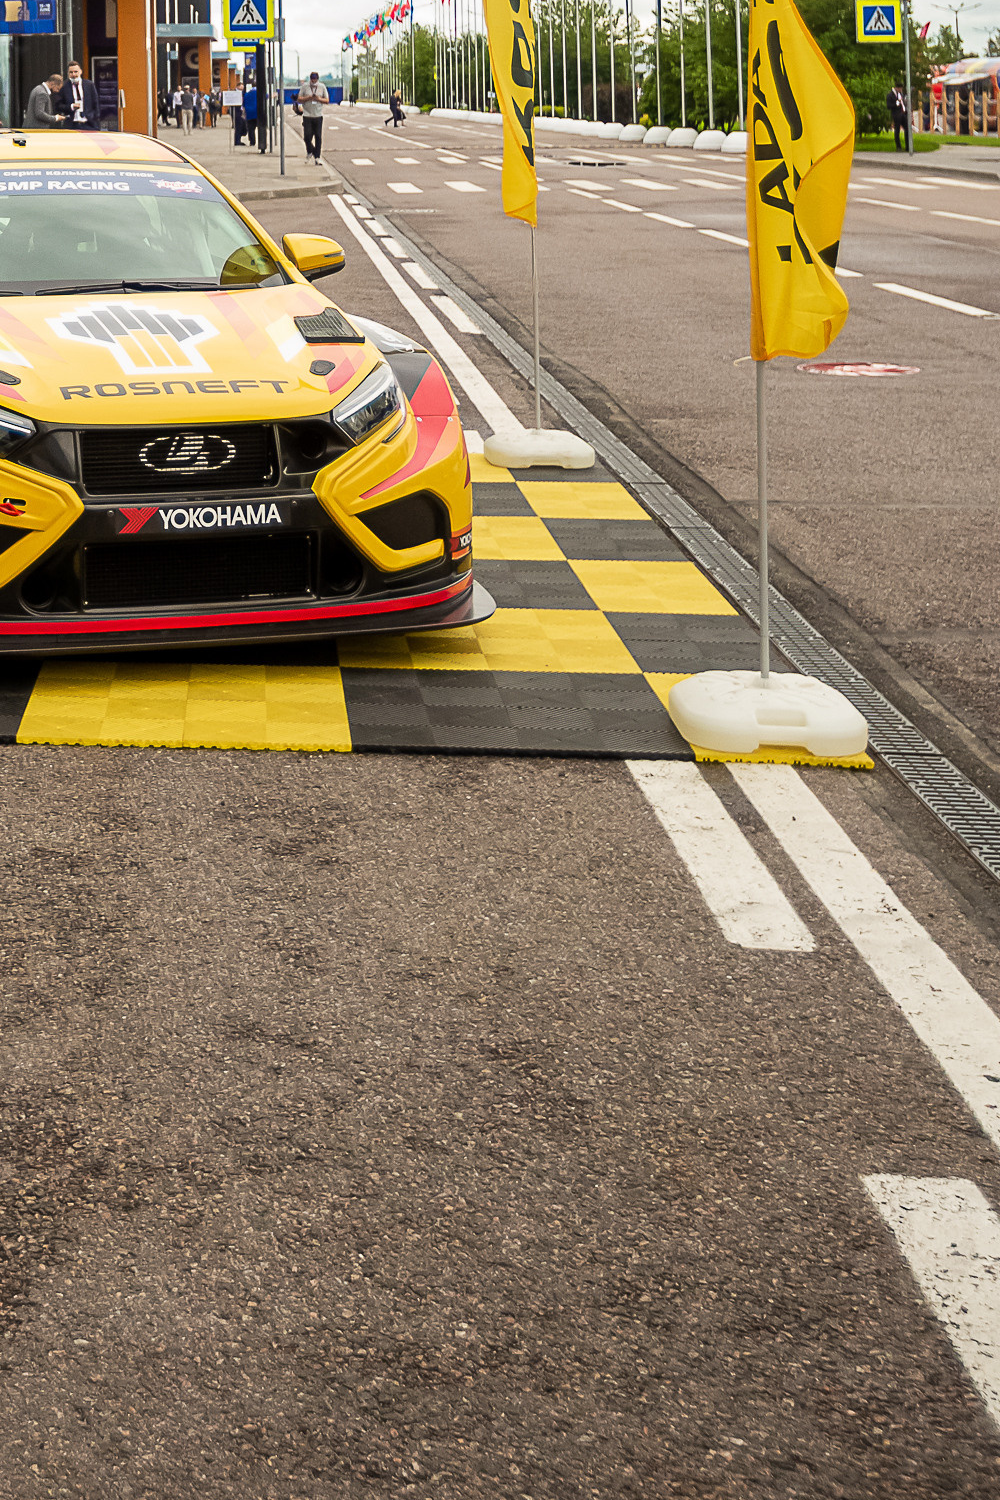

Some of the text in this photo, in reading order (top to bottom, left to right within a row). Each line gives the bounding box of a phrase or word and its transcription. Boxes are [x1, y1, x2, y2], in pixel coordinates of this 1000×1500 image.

[3, 170, 42, 178] серия
[46, 170, 116, 178] кольцевых
[119, 170, 155, 178] гонок
[47, 180, 130, 192] RACING
[59, 379, 289, 401] ROSNEFT
[158, 503, 282, 530] YOKOHAMA
